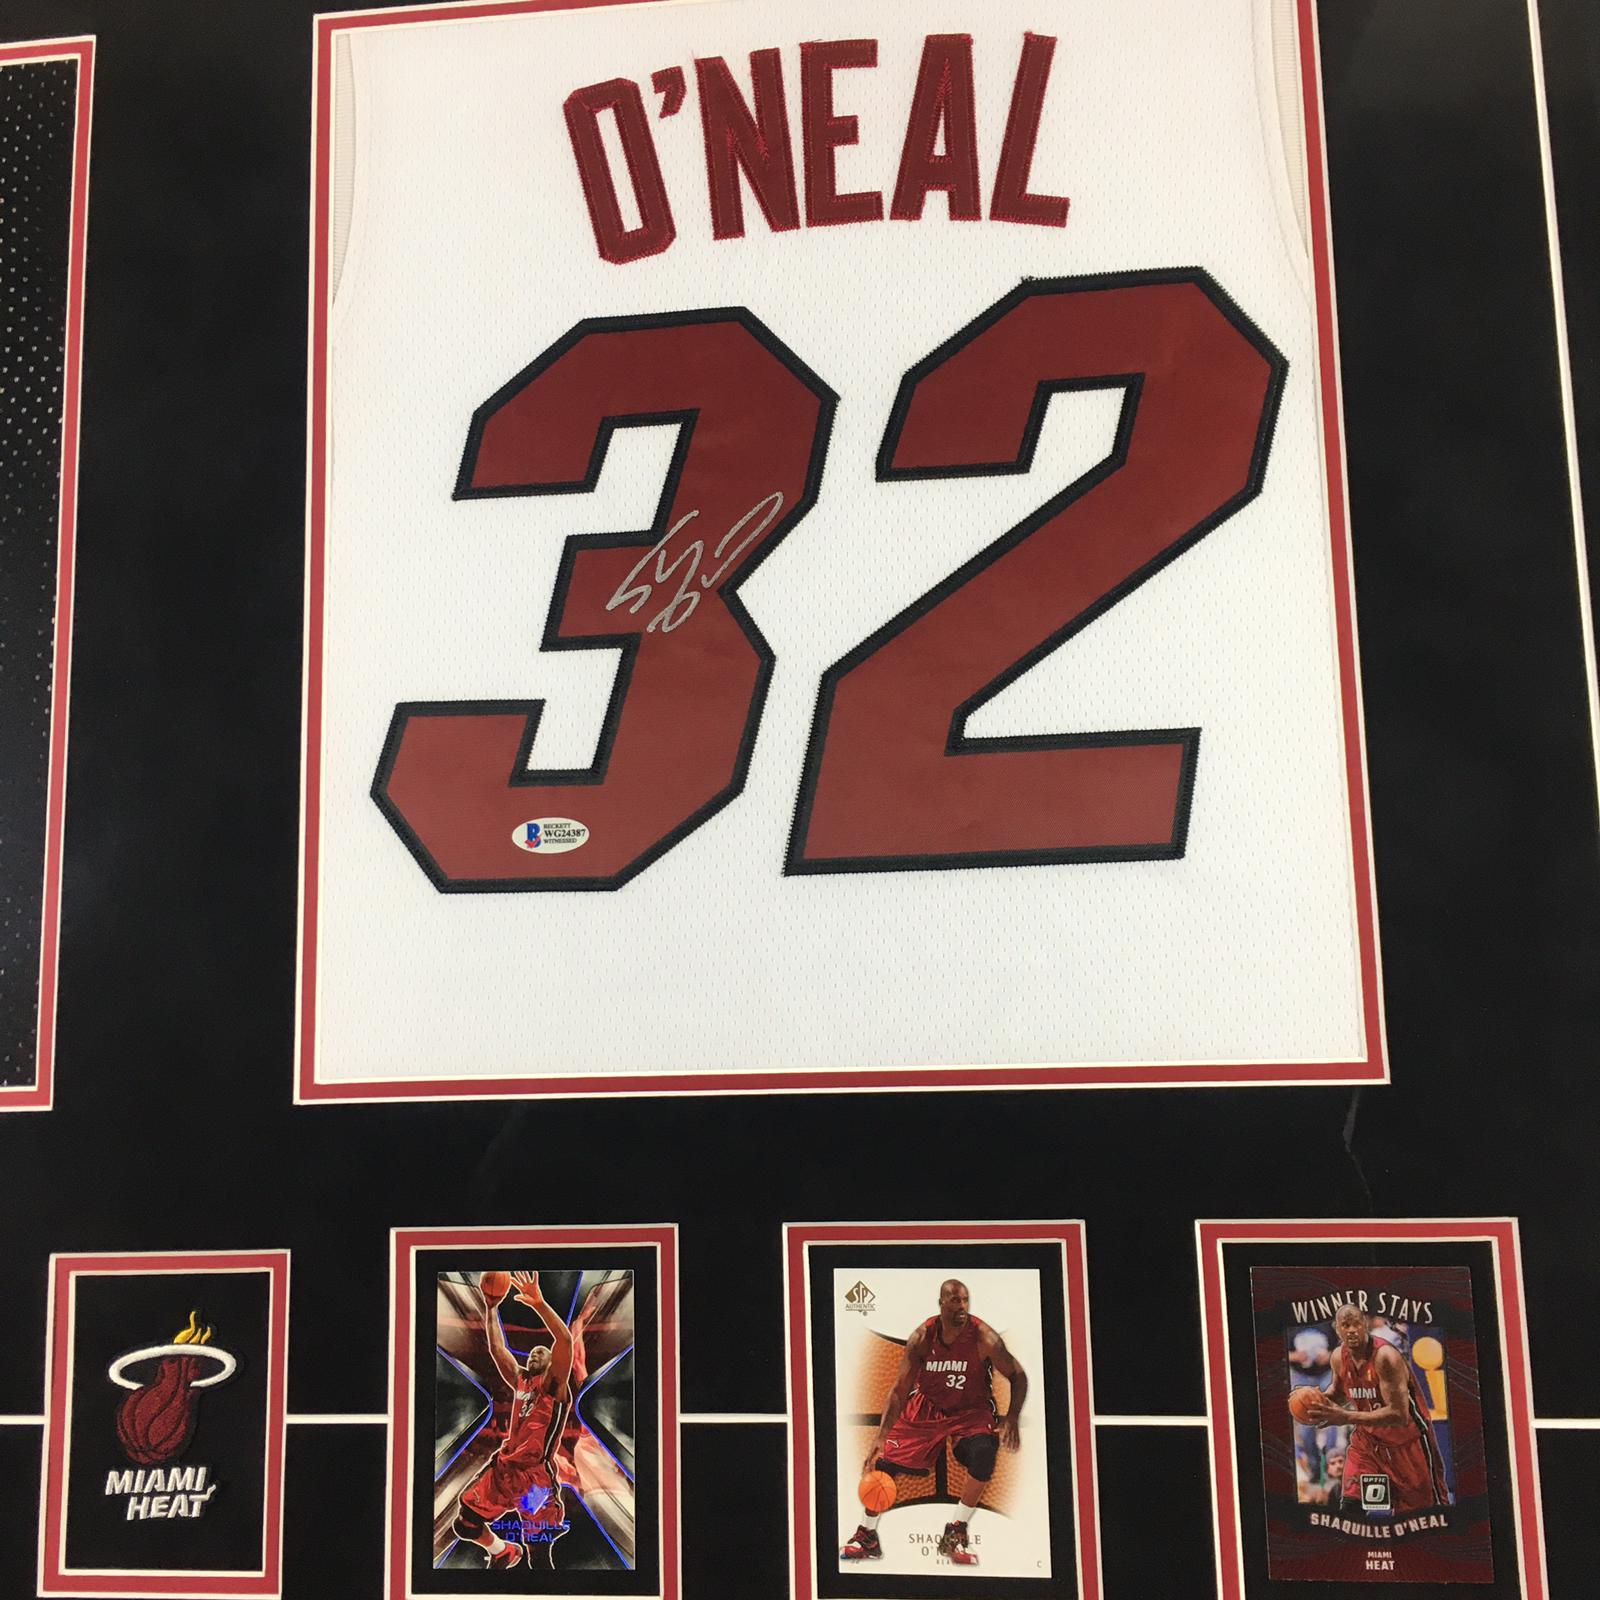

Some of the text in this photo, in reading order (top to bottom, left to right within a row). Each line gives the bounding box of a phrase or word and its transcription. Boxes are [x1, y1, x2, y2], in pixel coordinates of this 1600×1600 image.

[563, 32, 1071, 265] O'NEAL
[370, 266, 1290, 894] 32
[544, 829, 587, 838] WG24387
[1291, 1289, 1433, 1325] WINNER STAYS
[926, 1360, 968, 1372] MIAMI
[945, 1374, 967, 1390] 32
[518, 1402, 535, 1418] 32
[105, 1466, 207, 1496] MIAMI
[126, 1484, 217, 1521] HEAT
[492, 1519, 571, 1530] SHAQUILLE
[1310, 1513, 1448, 1539] SHAQUILLE O'NEAL
[505, 1531, 557, 1543] O'NEAL
[1367, 1551, 1393, 1559] MIAMI
[1365, 1560, 1395, 1571] HEAT
